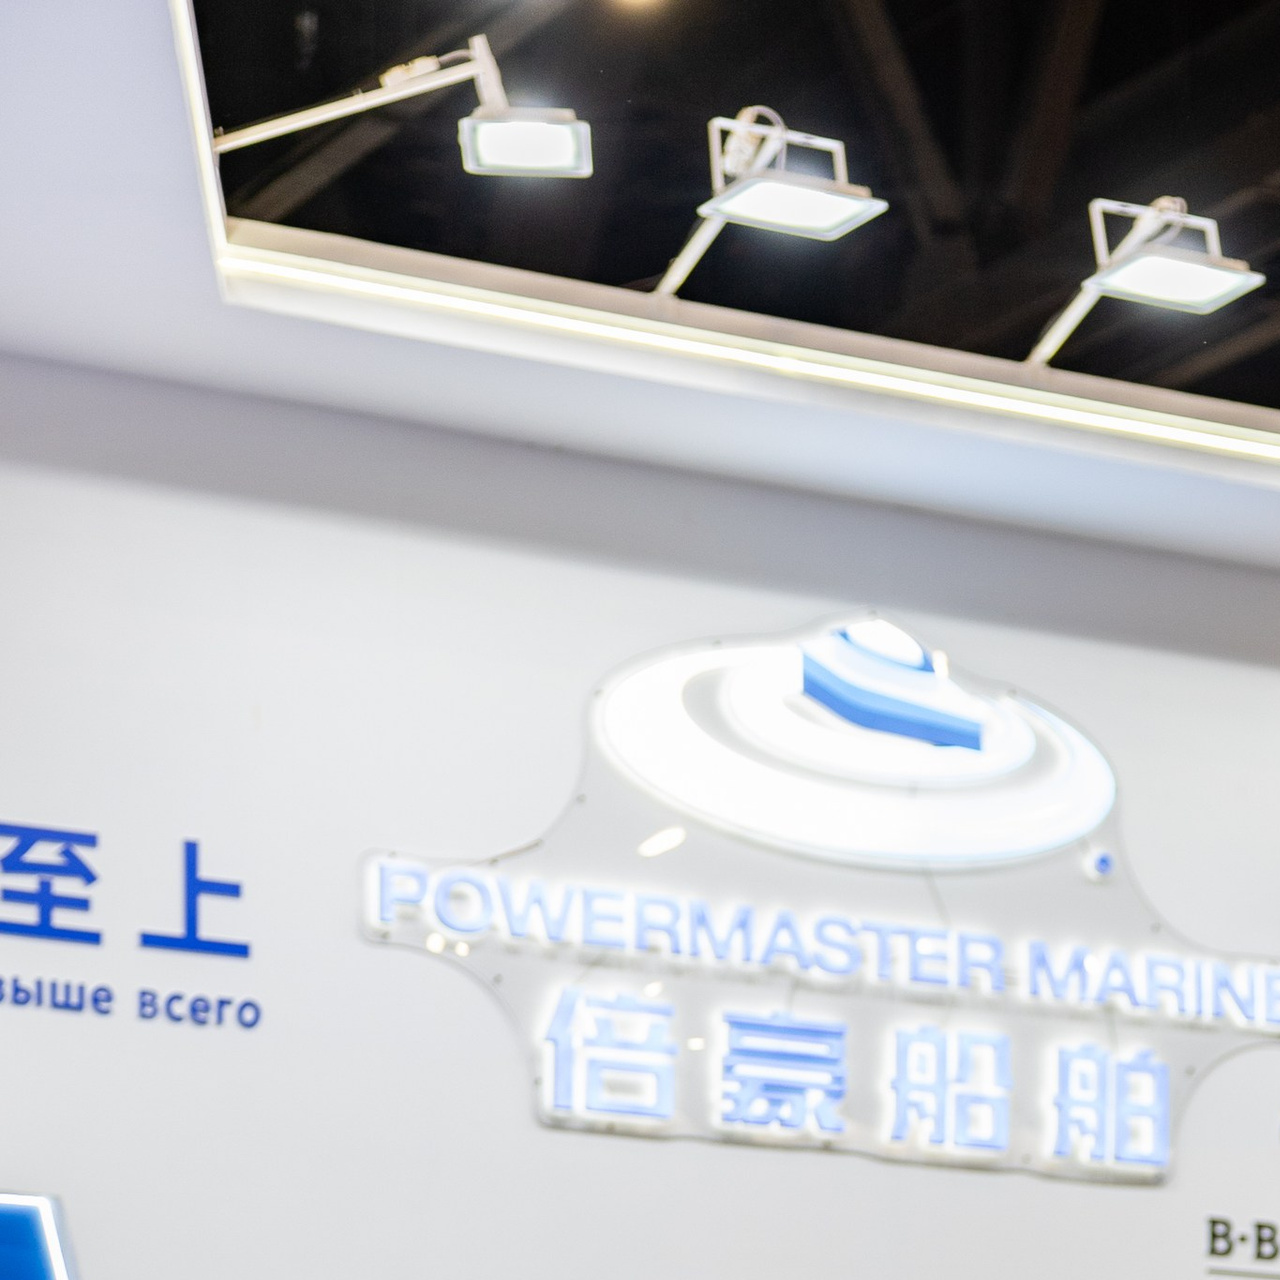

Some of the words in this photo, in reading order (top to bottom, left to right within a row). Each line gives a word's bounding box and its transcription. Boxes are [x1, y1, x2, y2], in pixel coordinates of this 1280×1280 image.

[0, 823, 250, 957] 至上
[378, 862, 1004, 992] POWERMASTER
[0, 976, 114, 1015] ыше
[138, 989, 261, 1029] всего
